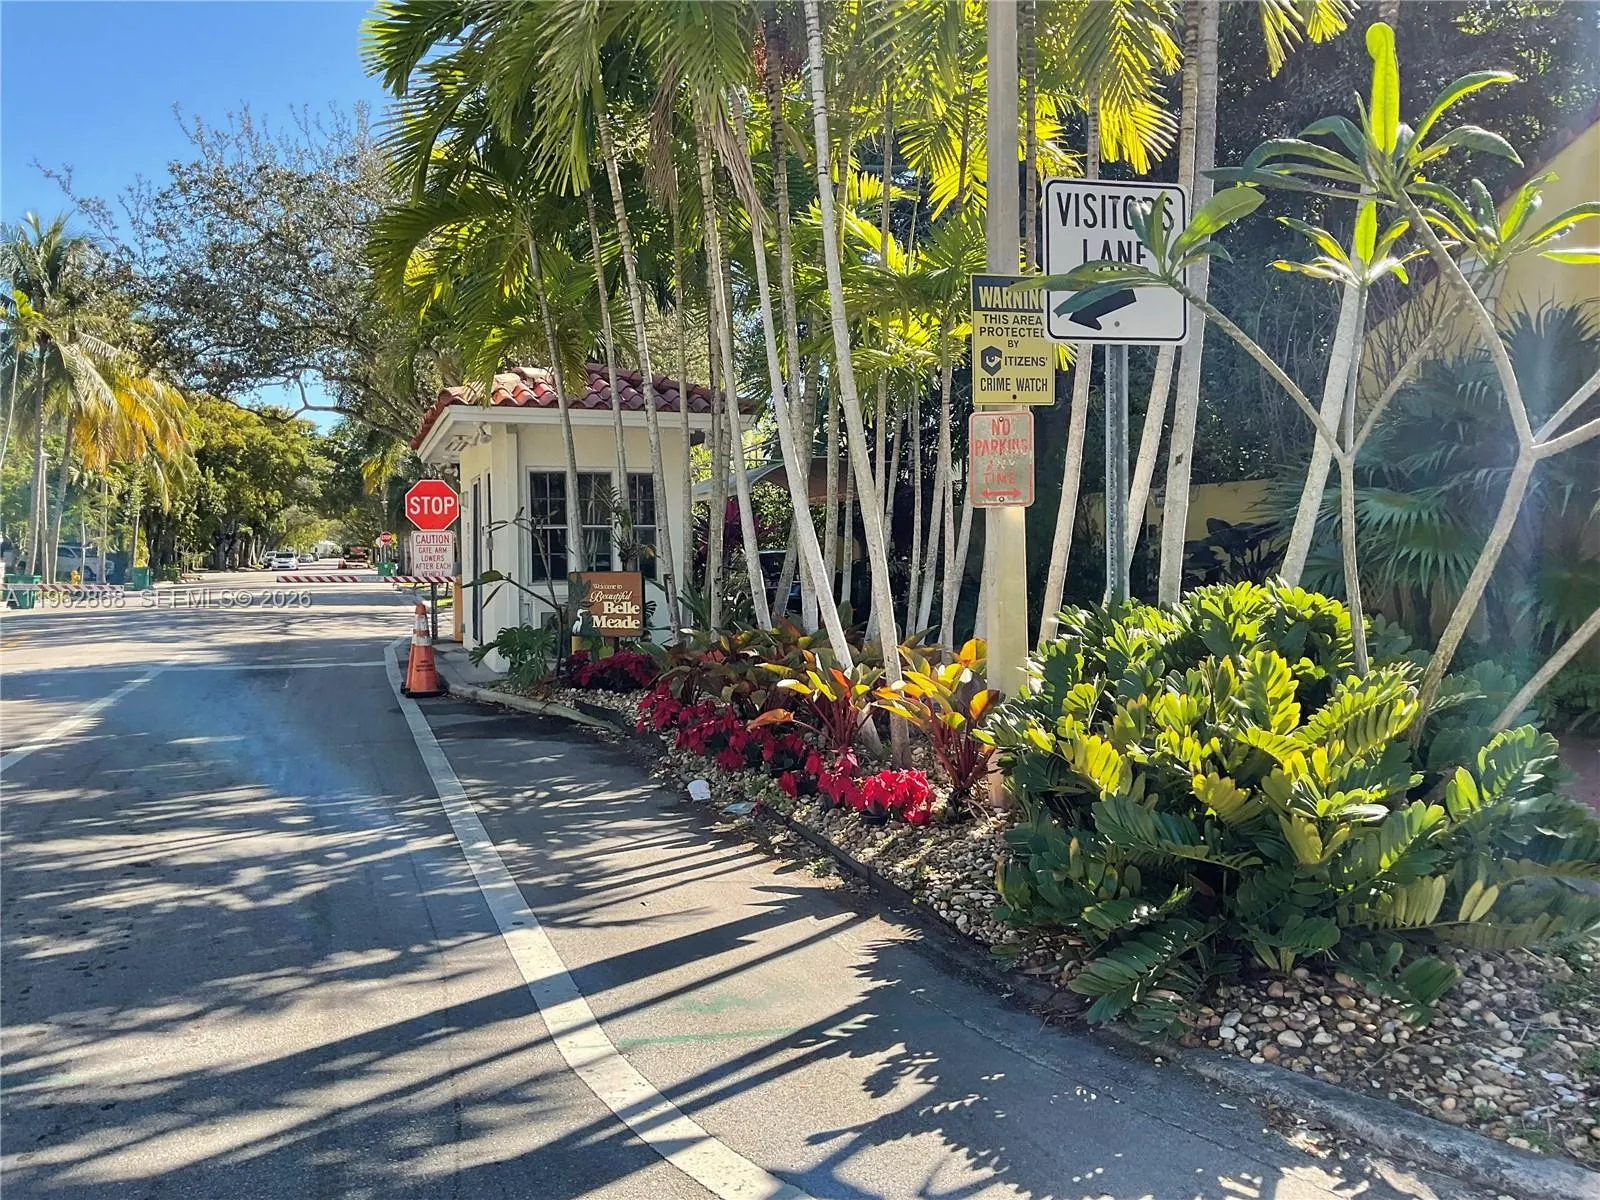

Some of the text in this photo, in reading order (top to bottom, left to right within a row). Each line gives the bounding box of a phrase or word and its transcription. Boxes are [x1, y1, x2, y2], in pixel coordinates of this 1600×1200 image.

[1056, 192, 1175, 231] VISITOS
[983, 314, 1043, 326] THIS AREA
[1007, 340, 1019, 348] BY
[980, 377, 1048, 392] CRIME WATCH
[991, 419, 1011, 436] NO
[409, 496, 455, 515] STOP
[415, 534, 450, 544] CAUTION
[421, 554, 445, 562] LOWERS
[590, 591, 632, 603] Beautiful
[603, 602, 640, 614] Belle
[592, 616, 640, 628] Meade
